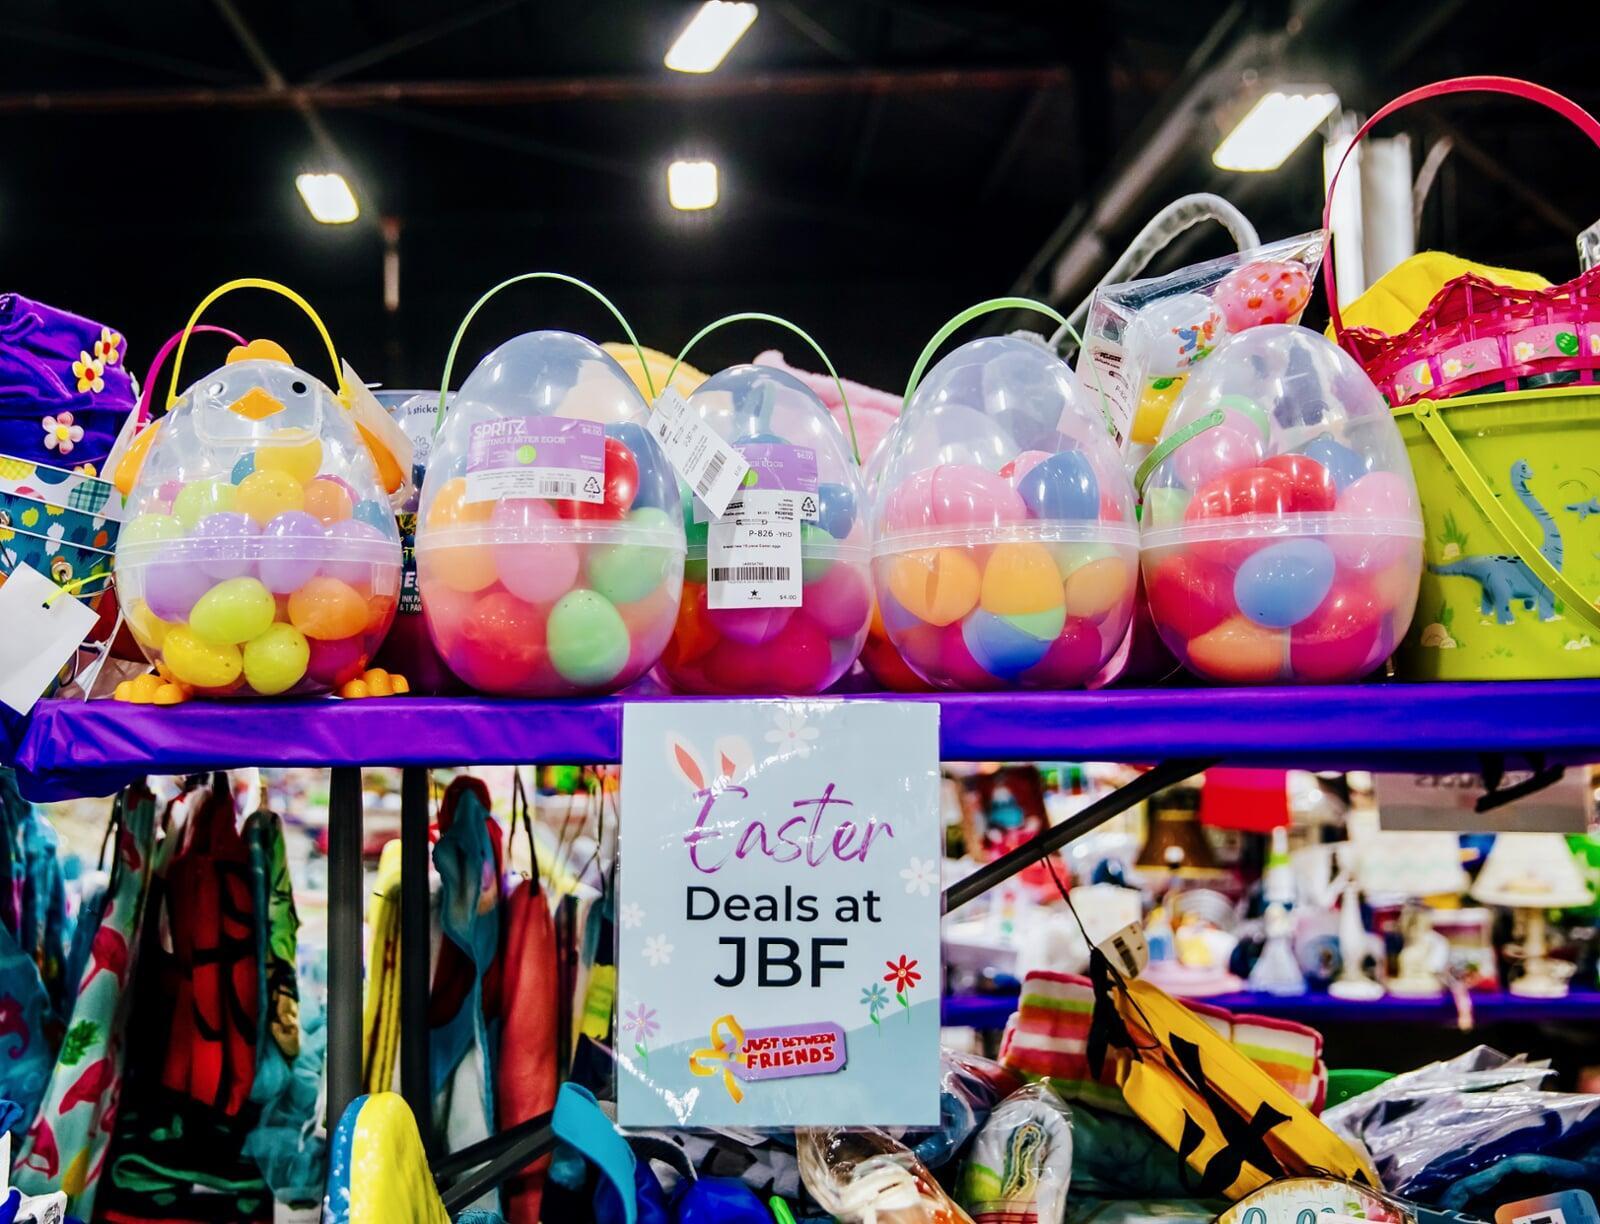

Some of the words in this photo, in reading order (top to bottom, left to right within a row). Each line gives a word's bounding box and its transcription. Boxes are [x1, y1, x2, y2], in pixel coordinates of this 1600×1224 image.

[412, 404, 440, 415] sticke
[473, 418, 527, 438] SPRITZ
[748, 529, 774, 538] P-826
[683, 782, 894, 873] Easter
[686, 885, 819, 922] Deals
[834, 890, 882, 922] at
[714, 936, 848, 988] JBF
[742, 1037, 780, 1053] JUST
[782, 1032, 836, 1048] BETWEEN
[747, 1047, 835, 1069] FRIENDS
